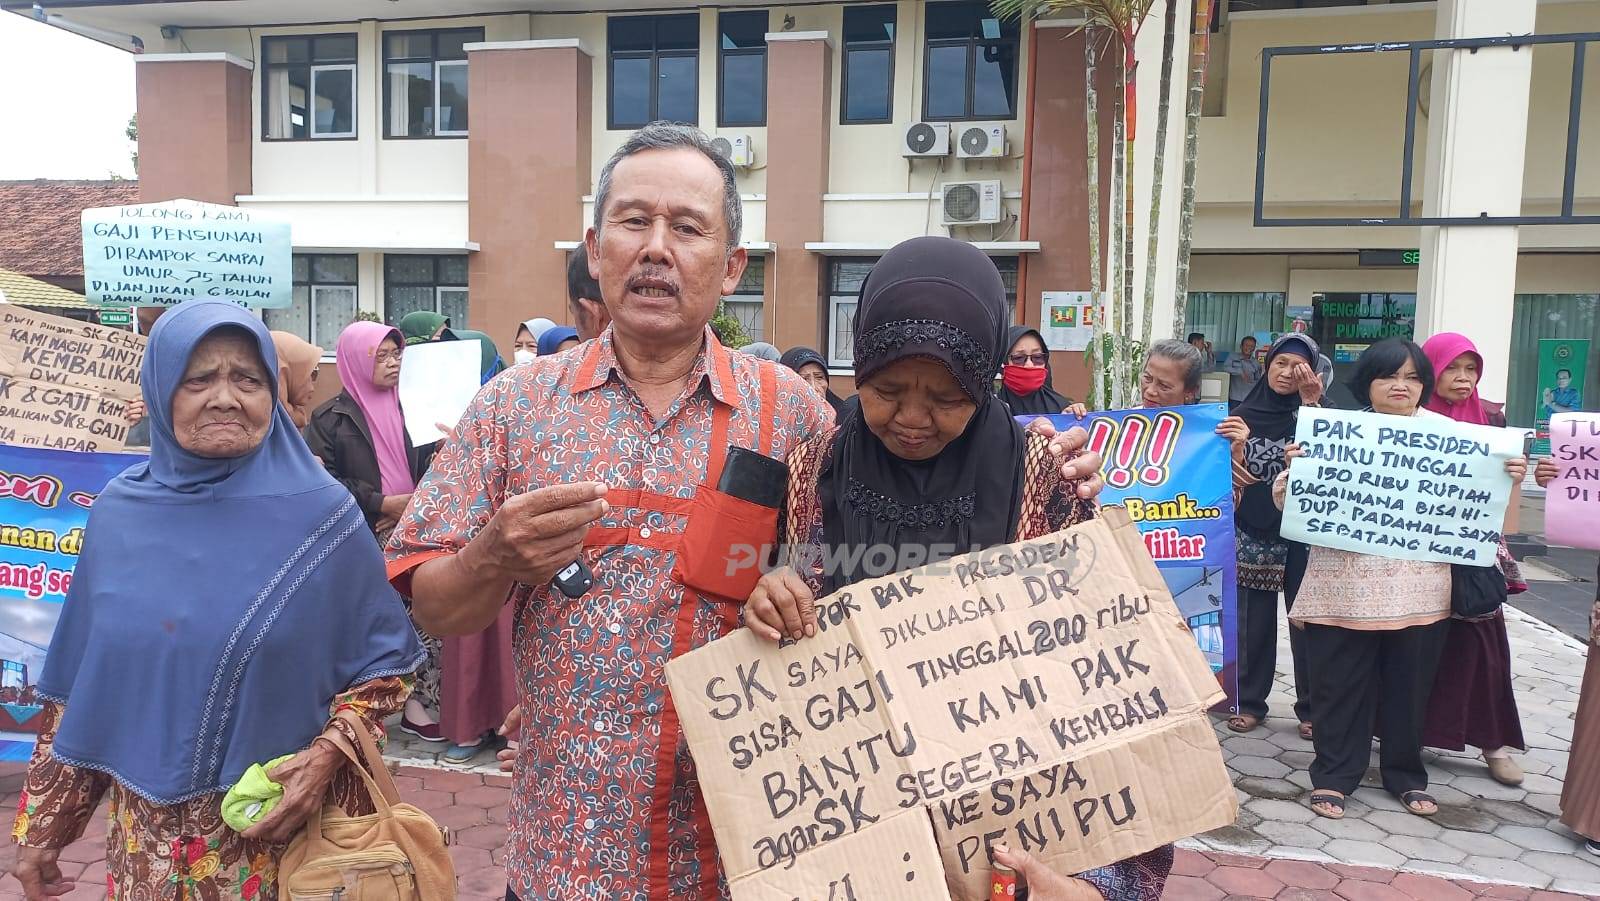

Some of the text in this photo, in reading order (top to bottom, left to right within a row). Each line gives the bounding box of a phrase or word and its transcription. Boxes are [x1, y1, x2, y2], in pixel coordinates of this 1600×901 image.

[93, 222, 262, 243] GAJI PENSIUNAN
[104, 245, 265, 266] DIRAMPOK SAMPAI
[123, 266, 272, 285] UMUR 75 TAHUN
[225, 287, 270, 299] BULAN
[102, 294, 142, 303] BANK
[10, 328, 48, 347] KAMI
[81, 326, 102, 340] SK
[42, 388, 91, 411] GAJI
[97, 397, 128, 420] KAM
[43, 434, 97, 452] LAPAR
[50, 410, 79, 430] SK
[89, 418, 126, 442] GAJI
[1312, 418, 1490, 457] PAK PRESIDEN
[1298, 440, 1473, 479] GAJIKU TINGGAL
[1290, 479, 1404, 511] BAGAIMANA
[1317, 466, 1492, 504] 150 RIBU RUPIAH
[1306, 518, 1477, 561] SEBATANG KARA
[1352, 506, 1454, 537] PADAHAL
[1458, 526, 1501, 545] SAYA
[871, 574, 924, 609] PAK
[956, 534, 1079, 589] PRESIDEN
[705, 569, 1080, 721] SK SAYA DIKUASAI DR
[728, 594, 1150, 770] SISA GAJI TINGGAL 200 ribu
[762, 639, 1150, 819] BANTU KAMI PAK
[896, 737, 1039, 809] SEGERA
[1050, 686, 1168, 750] KEMBALI
[957, 786, 1137, 874] PENIPU
